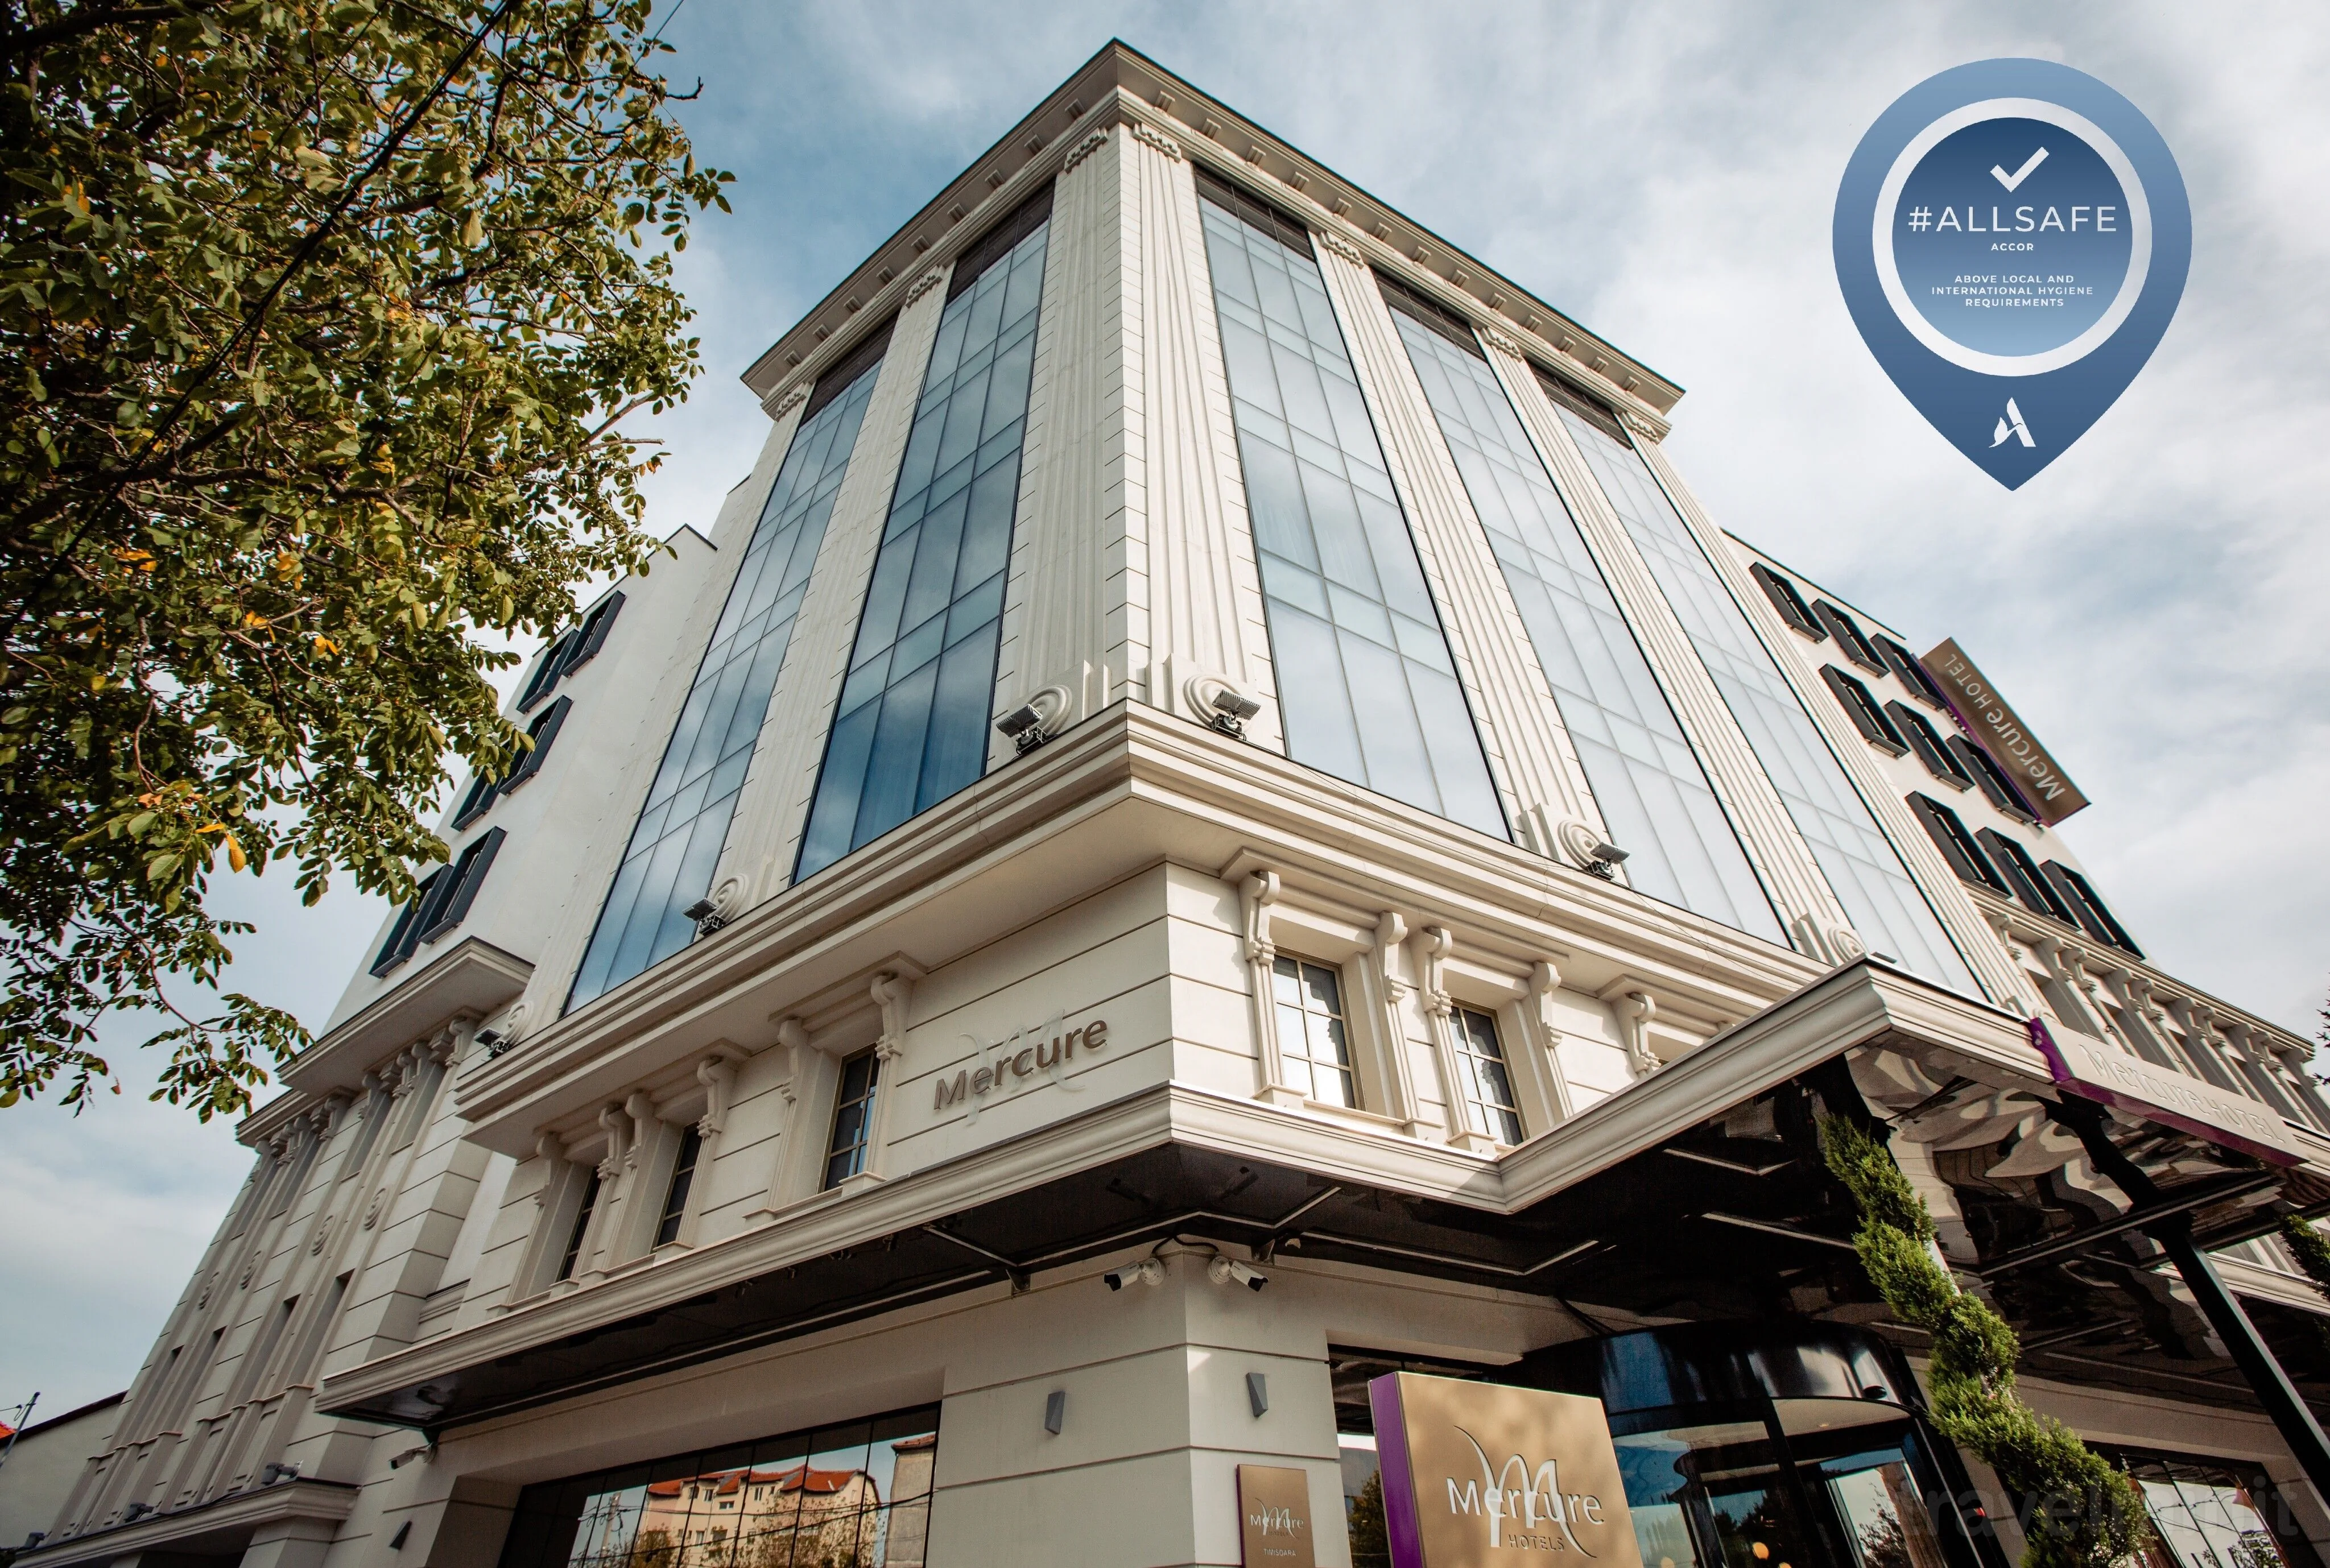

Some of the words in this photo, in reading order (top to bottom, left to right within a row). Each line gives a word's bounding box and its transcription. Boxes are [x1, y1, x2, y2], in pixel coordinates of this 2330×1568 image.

[1944, 653, 1993, 709] HOTEL
[1986, 708, 2066, 801] Mercure
[933, 1020, 1108, 1110] Mercure
[2079, 1044, 2209, 1115] Mercure
[2205, 1098, 2286, 1143] HOTEL
[1263, 1548, 1296, 1557] TIMISOARA
[1509, 1534, 1564, 1551] HOTELS
